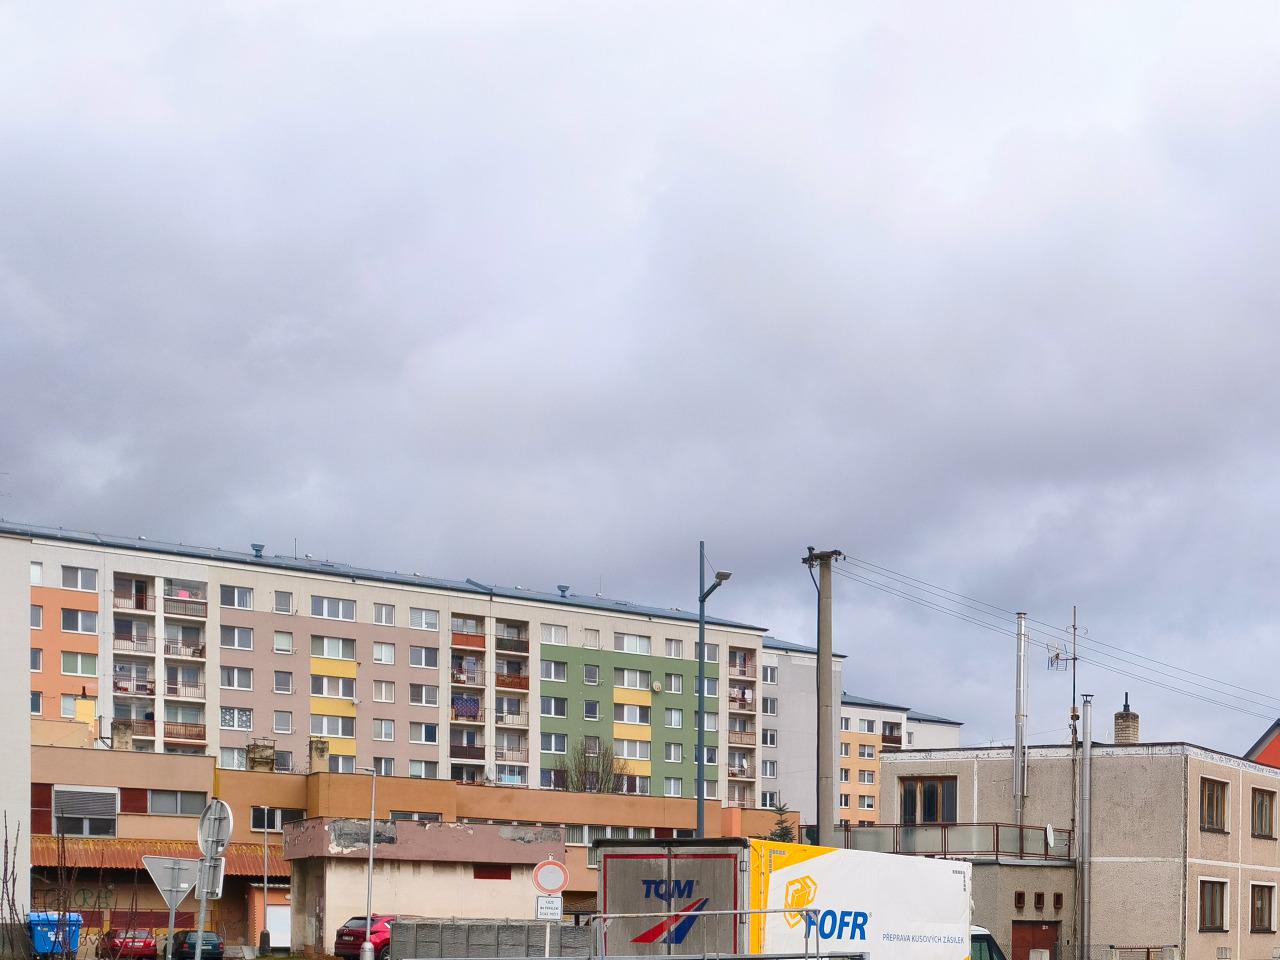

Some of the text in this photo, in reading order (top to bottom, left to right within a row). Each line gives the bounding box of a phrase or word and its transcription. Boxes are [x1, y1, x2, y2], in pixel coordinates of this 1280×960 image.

[641, 879, 695, 902] TQM
[806, 909, 869, 940] FOFR
[882, 932, 965, 944] PŘEPRAVA KUSOVÝCH ZÁSILEK
